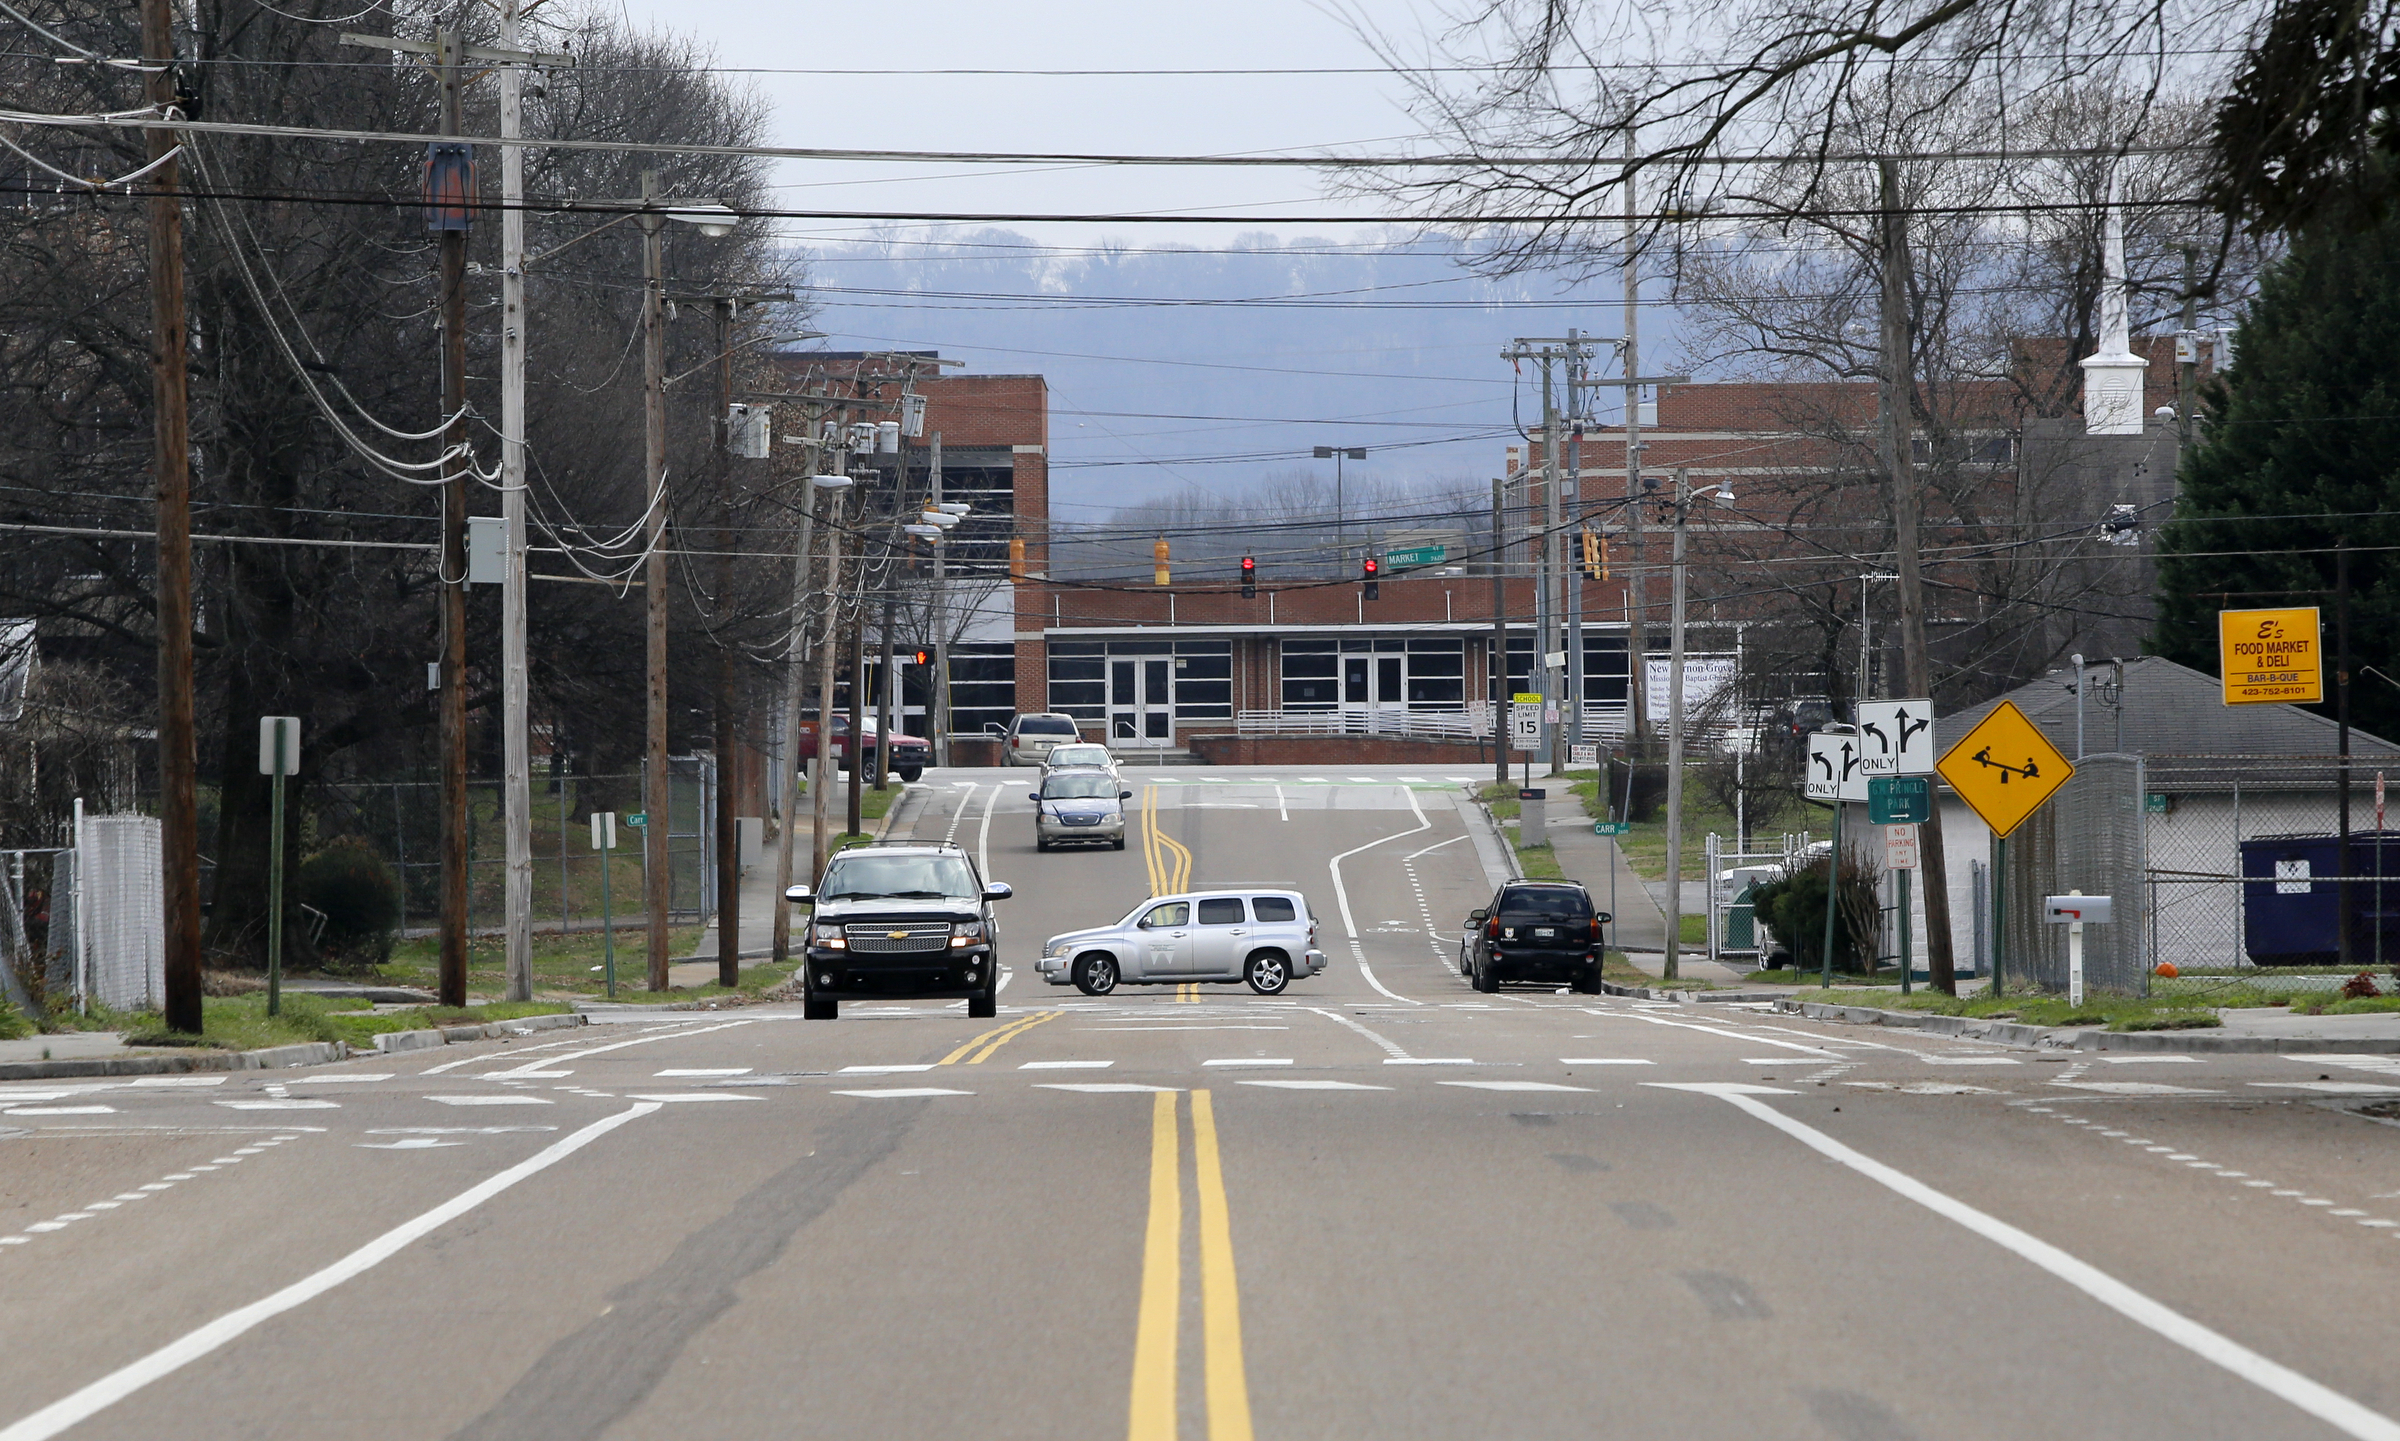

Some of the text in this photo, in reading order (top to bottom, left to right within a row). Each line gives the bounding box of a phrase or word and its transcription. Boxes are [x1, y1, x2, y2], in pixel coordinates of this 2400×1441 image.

[1388, 552, 1420, 564] MARKET
[2257, 620, 2285, 639] E's
[2234, 640, 2309, 655] FOOD MARKET
[2257, 655, 2290, 668] & DELI
[1649, 663, 1669, 673] New
[1705, 663, 1733, 673] Grove
[1685, 675, 1708, 683] Baptist
[2247, 673, 2299, 683] BAR-B-QUE
[2241, 687, 2306, 695] 423-752-8101
[1520, 721, 1536, 734] 15
[1862, 757, 1895, 769] ONLY
[1808, 783, 1837, 794] ONLY
[1890, 781, 1925, 794] PRINGLE
[1887, 798, 1910, 809] PARK
[630, 816, 643, 824] Carr
[1595, 824, 1615, 834] CARR
[1894, 828, 1906, 837] NO
[1888, 838, 1914, 848] PARKING
